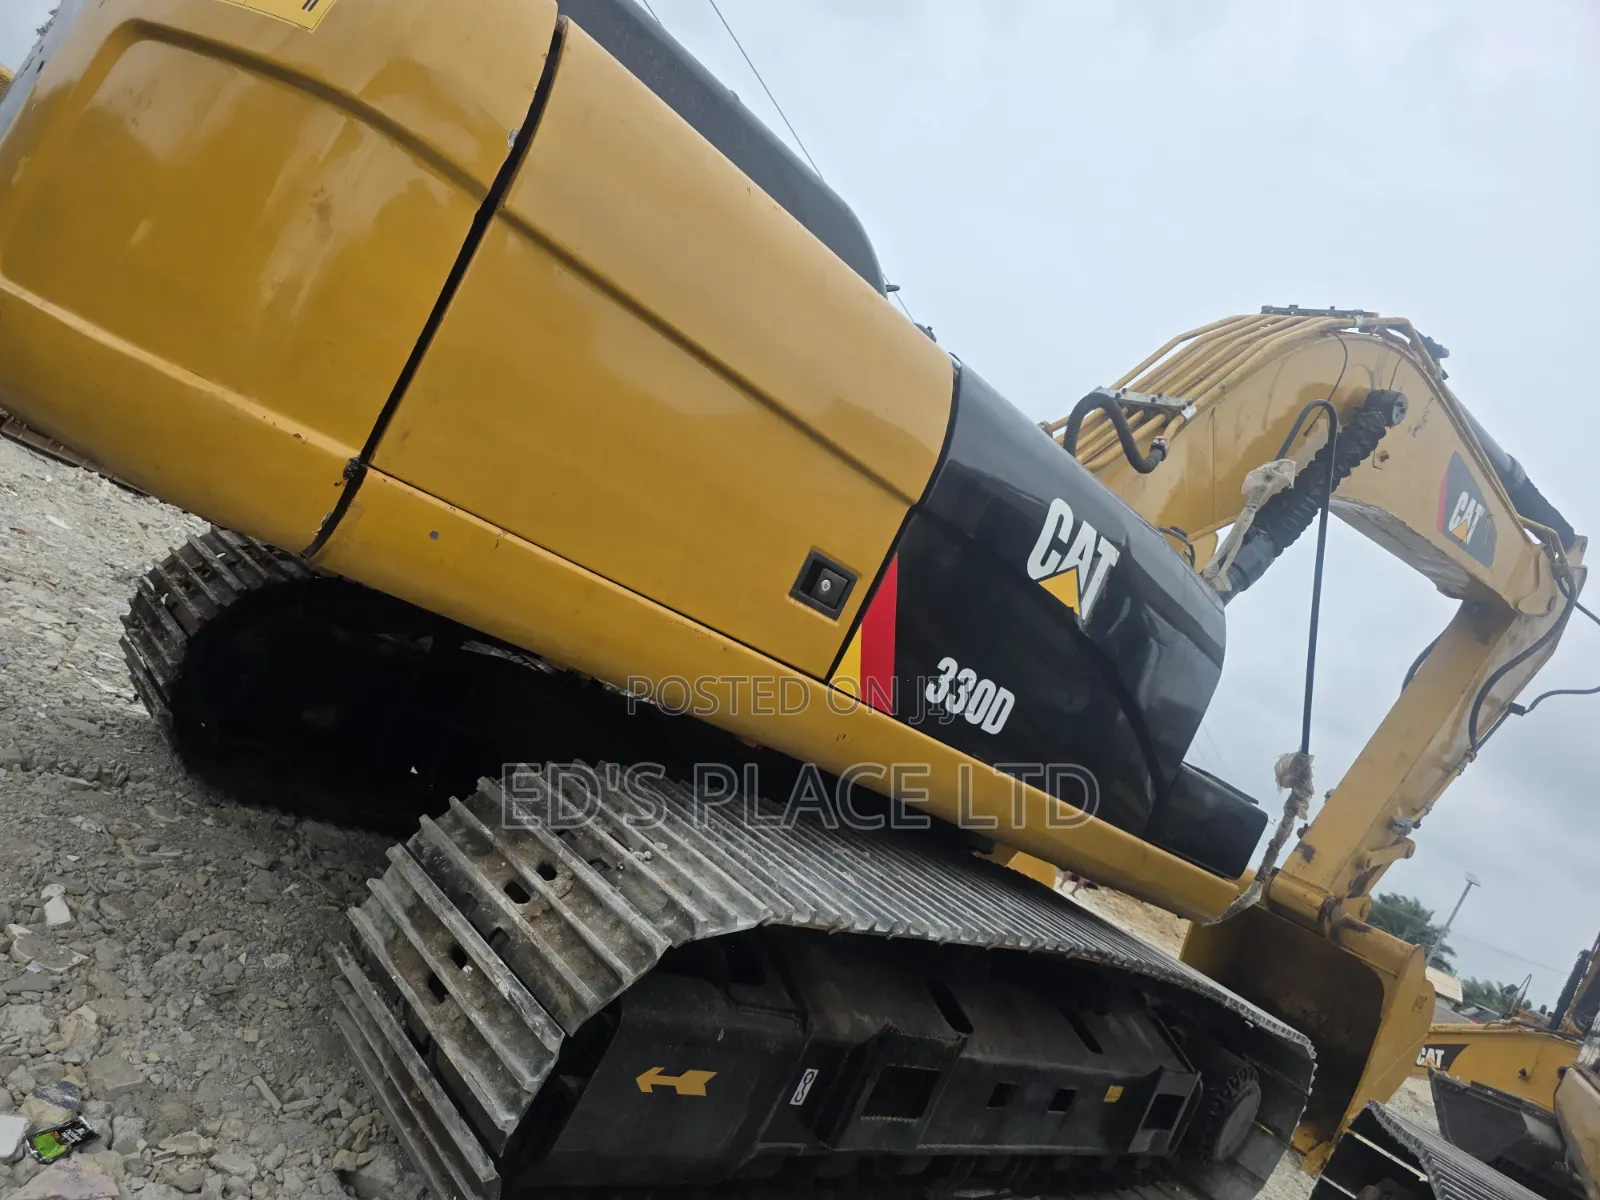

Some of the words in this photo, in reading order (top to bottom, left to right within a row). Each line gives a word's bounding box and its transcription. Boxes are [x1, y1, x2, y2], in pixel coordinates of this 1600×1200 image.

[1448, 491, 1486, 545] CAT
[1026, 498, 1120, 621] CAT
[925, 656, 1016, 735] 330D
[1416, 1047, 1445, 1069] CAT
